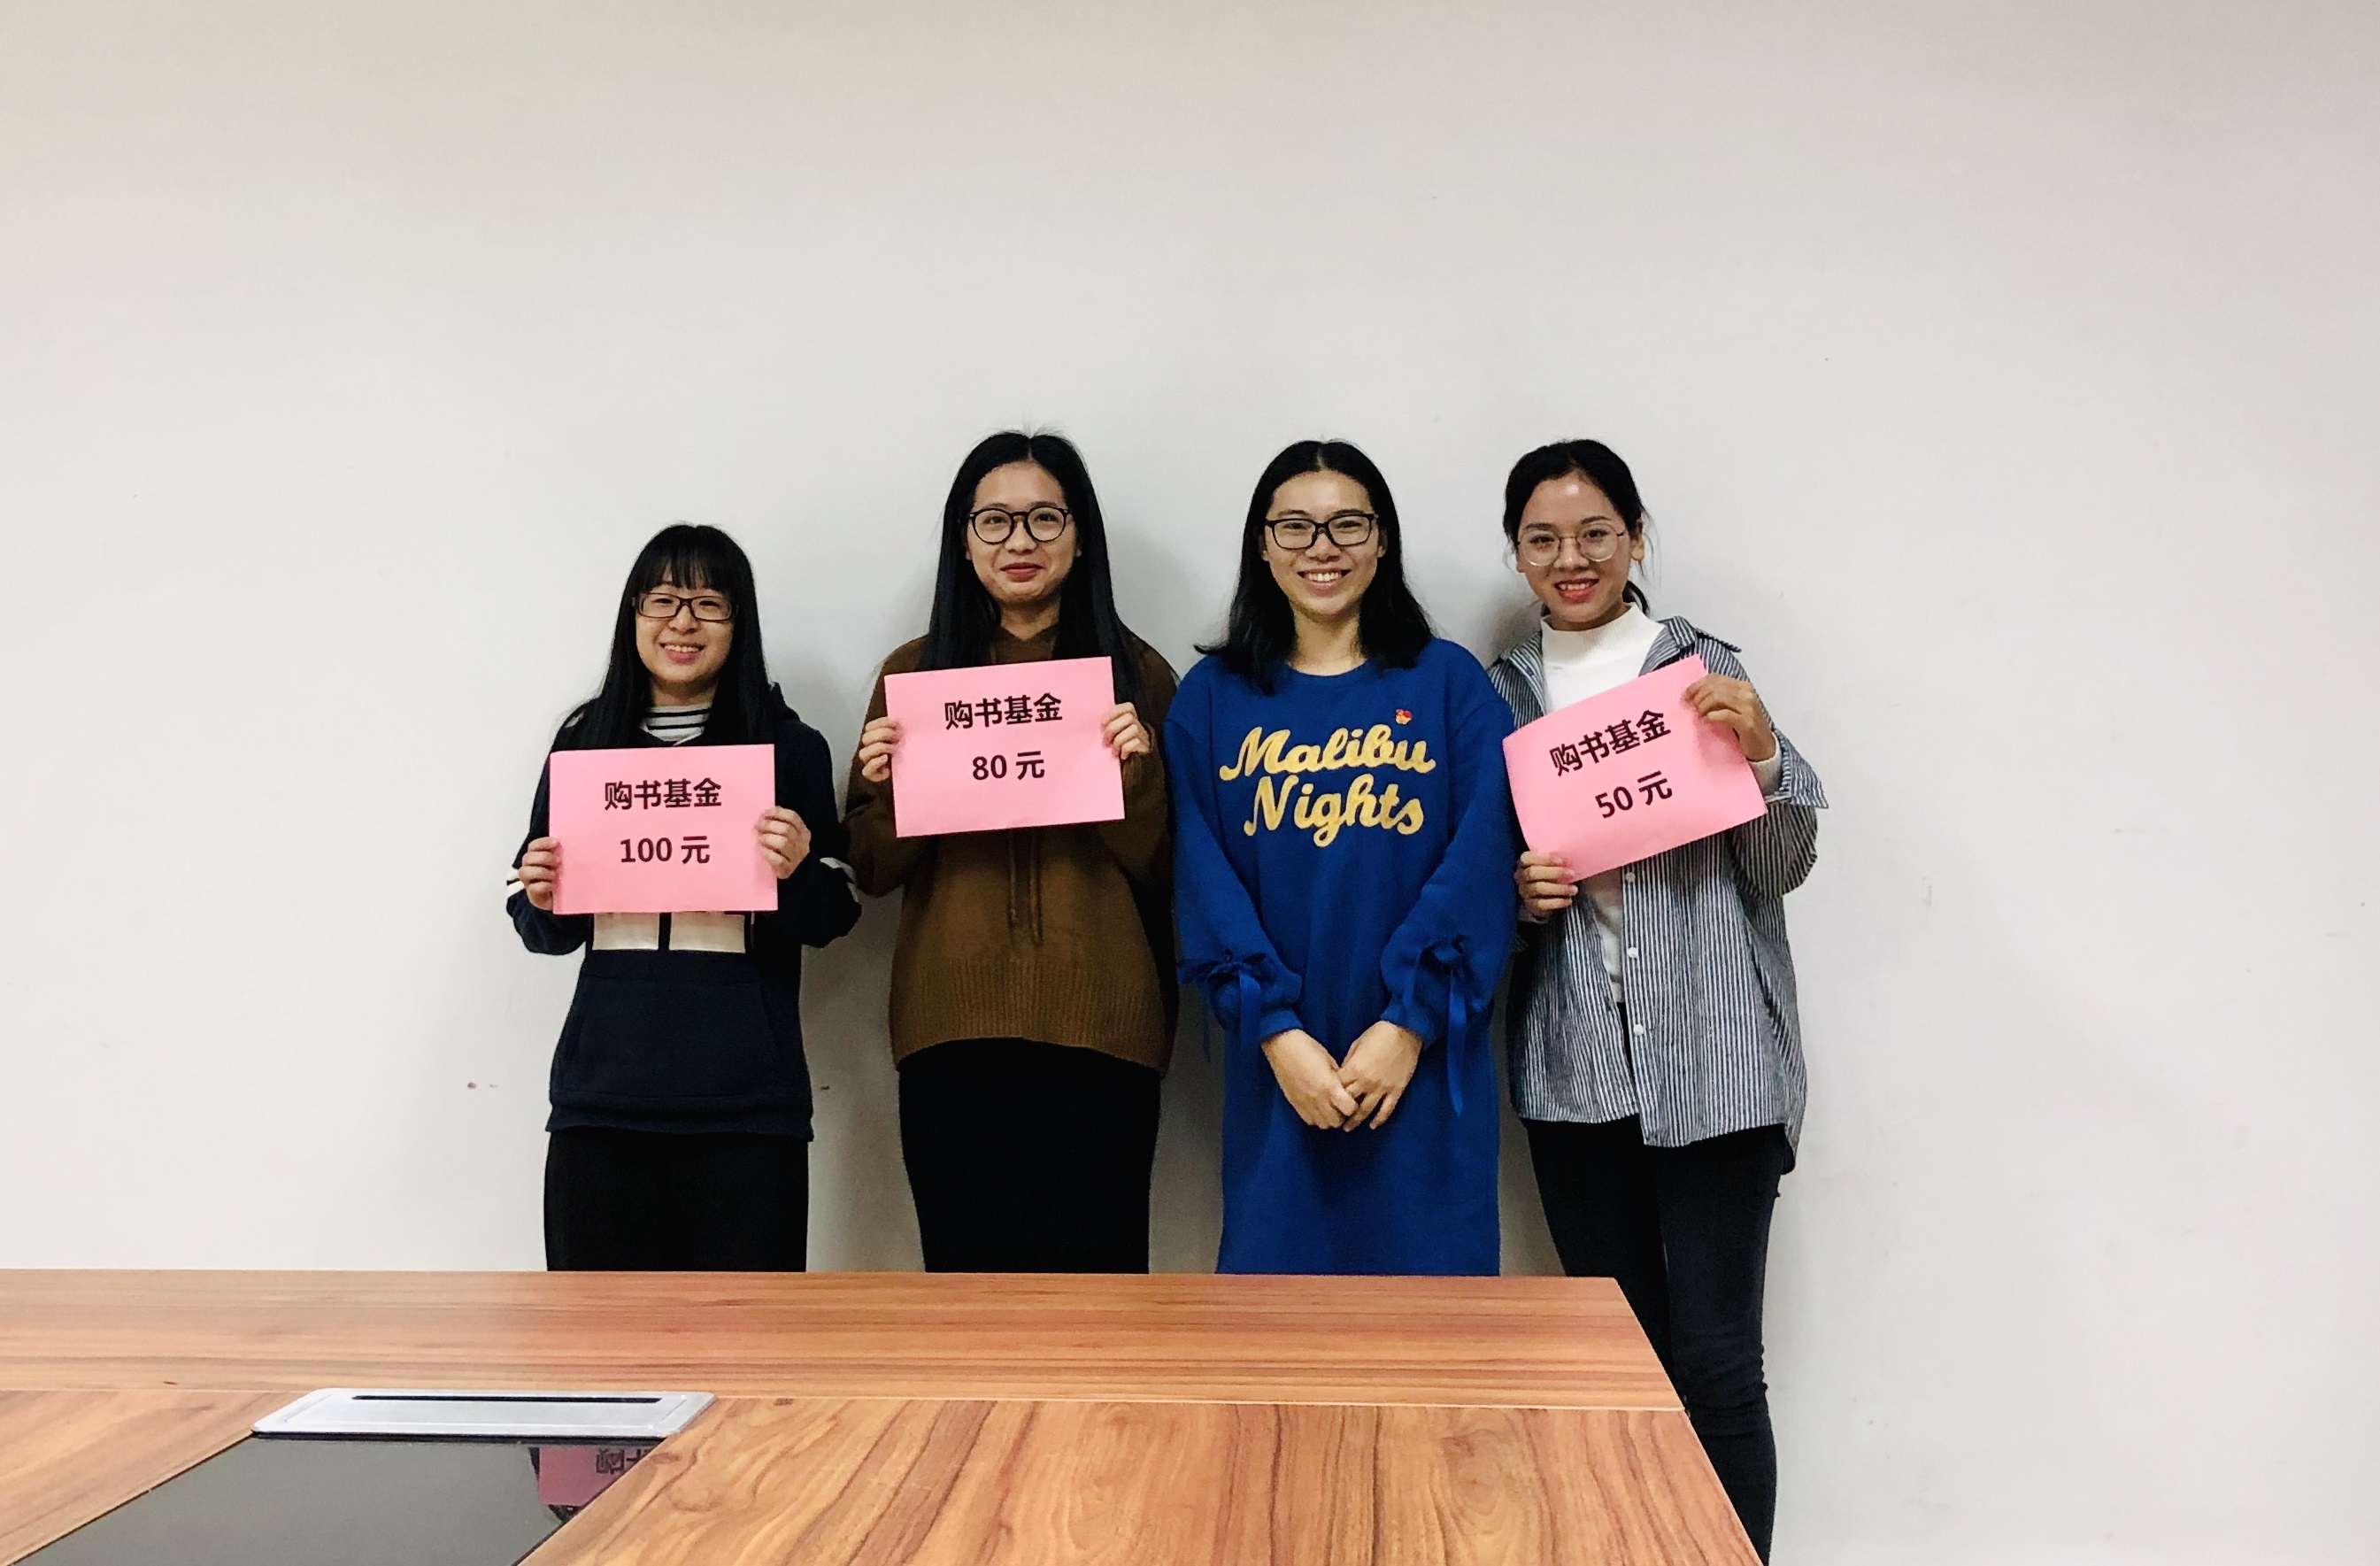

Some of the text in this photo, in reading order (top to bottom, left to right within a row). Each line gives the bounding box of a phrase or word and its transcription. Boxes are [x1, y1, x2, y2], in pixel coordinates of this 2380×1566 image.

[944, 692, 1063, 730] 购书基金
[1219, 723, 1436, 781] Malibu
[1549, 709, 1671, 776] 购书基金
[972, 751, 1045, 781] 80 元
[605, 777, 722, 811] 购书基金
[1244, 773, 1424, 847] Nights
[1595, 770, 1673, 819] 50 元
[620, 836, 711, 865] 100 元
